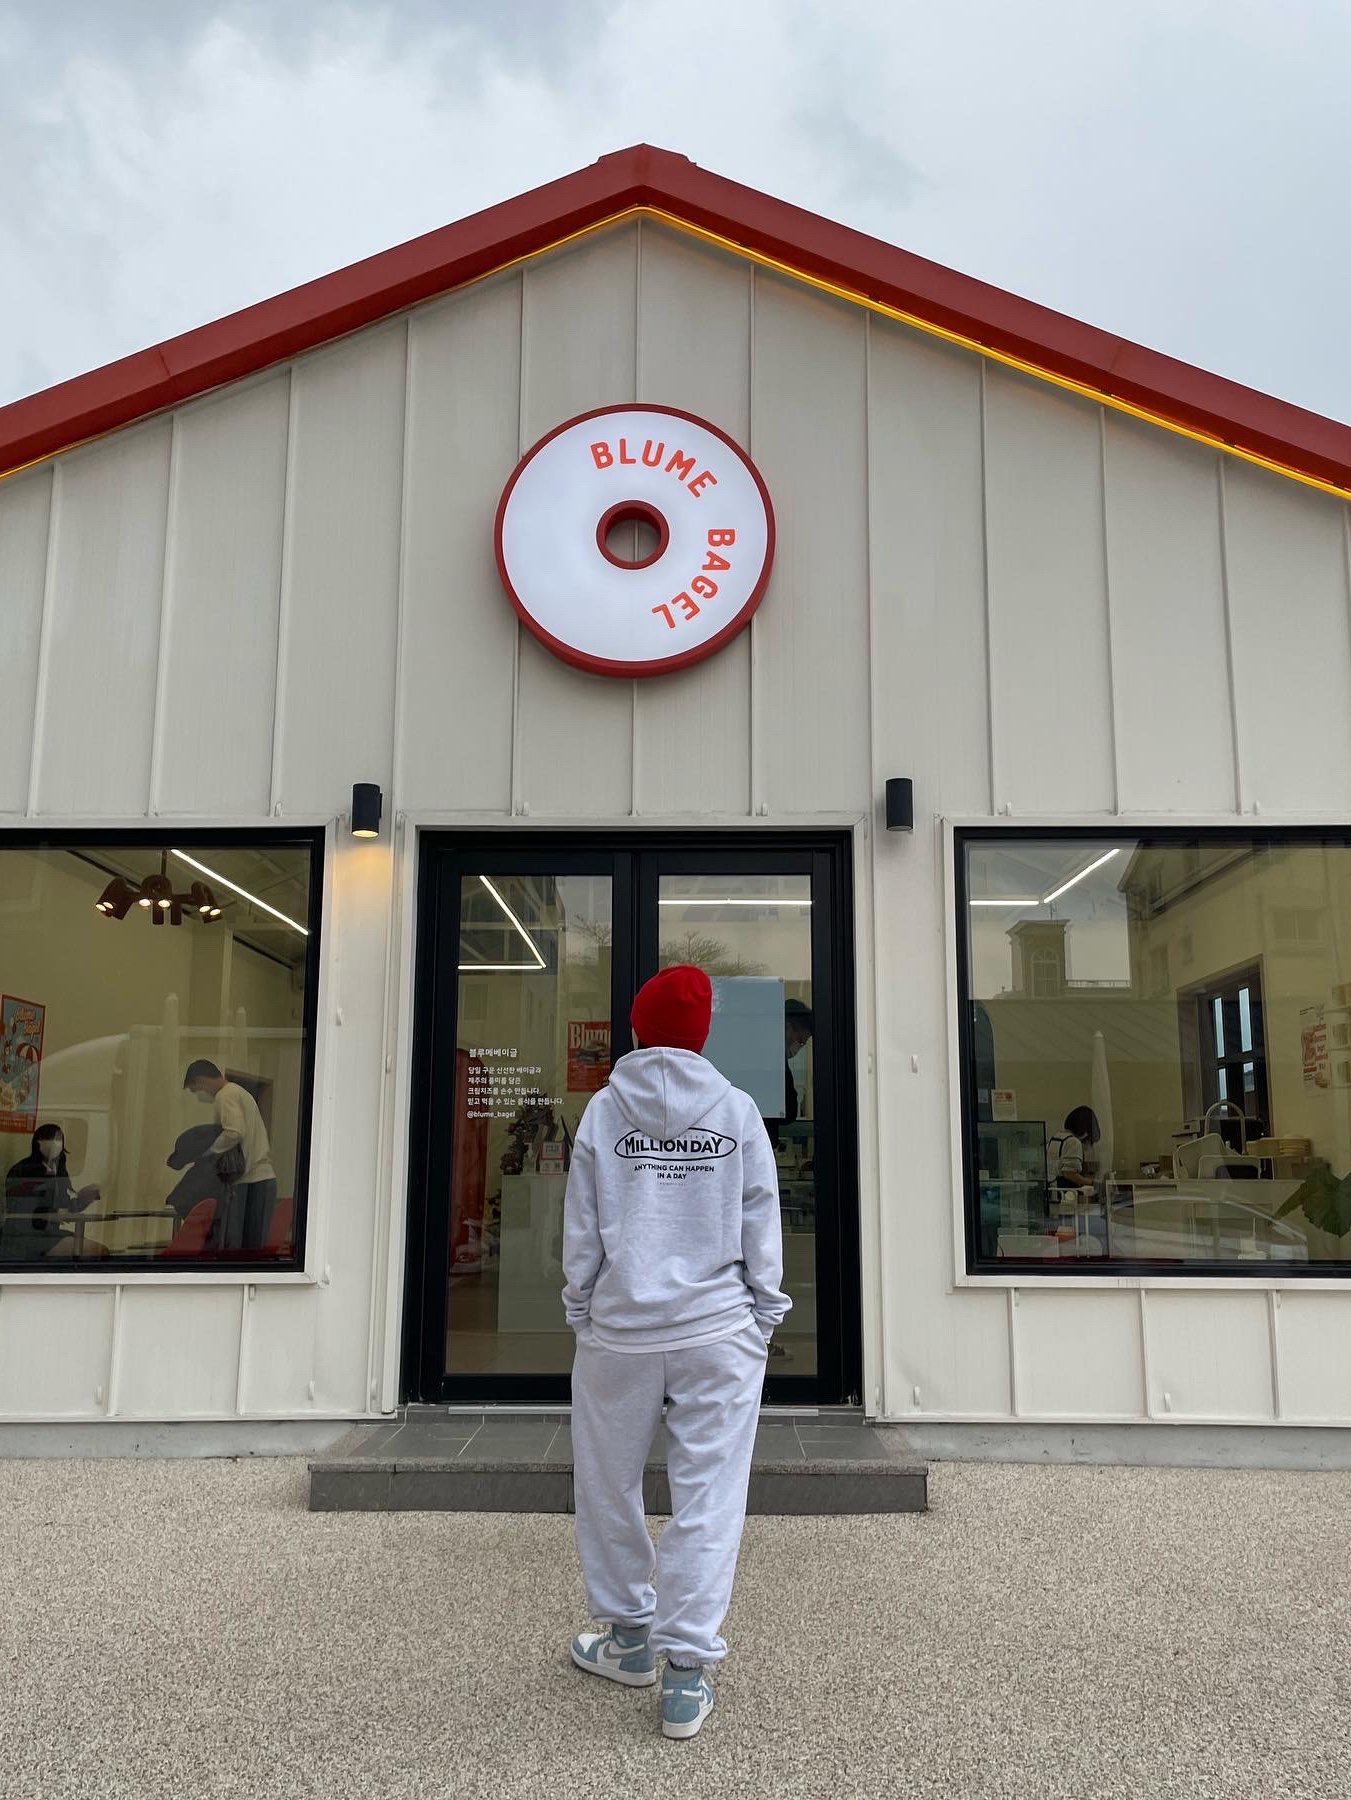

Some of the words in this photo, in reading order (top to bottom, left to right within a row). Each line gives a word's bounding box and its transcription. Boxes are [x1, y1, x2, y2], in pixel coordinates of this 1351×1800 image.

[590, 438, 718, 498] BLUME
[651, 528, 736, 629] BAGEL
[570, 1024, 611, 1049] Blum
[467, 1111, 515, 1119] @blume_bagel
[690, 1136, 723, 1154] DAY
[634, 1163, 668, 1172] ANYTHING
[669, 1164, 684, 1172] CAN
